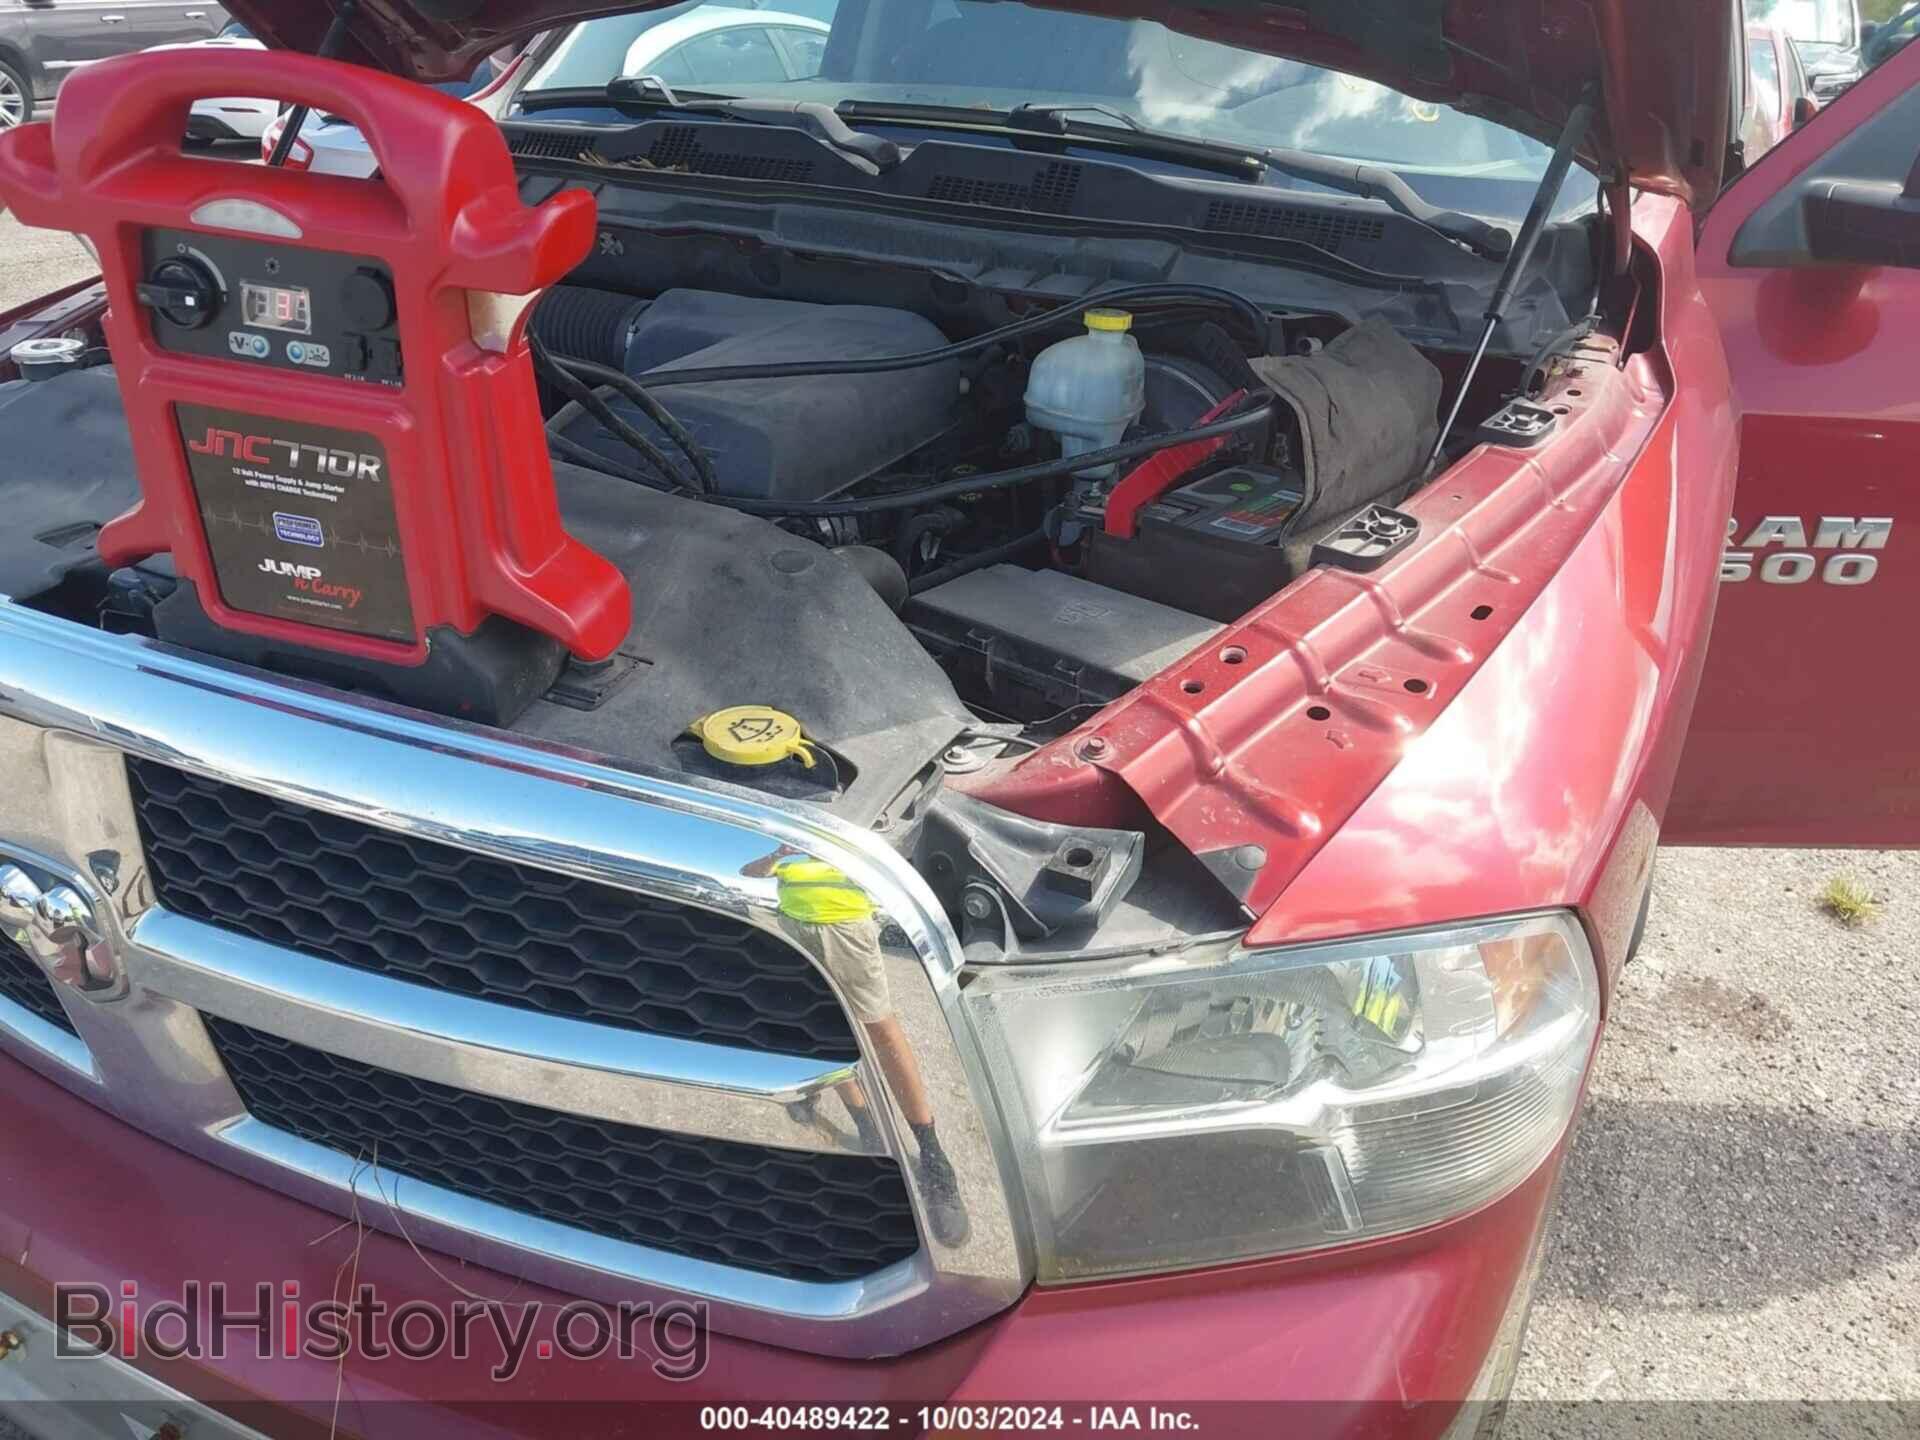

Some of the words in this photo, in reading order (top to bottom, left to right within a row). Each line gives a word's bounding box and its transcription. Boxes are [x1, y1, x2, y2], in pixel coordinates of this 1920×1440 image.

[188, 427, 383, 482] JNC770R
[1726, 516, 1893, 548] AM
[258, 558, 322, 579] JUMP
[1720, 552, 1878, 585] 500
[312, 579, 361, 607] Carry
